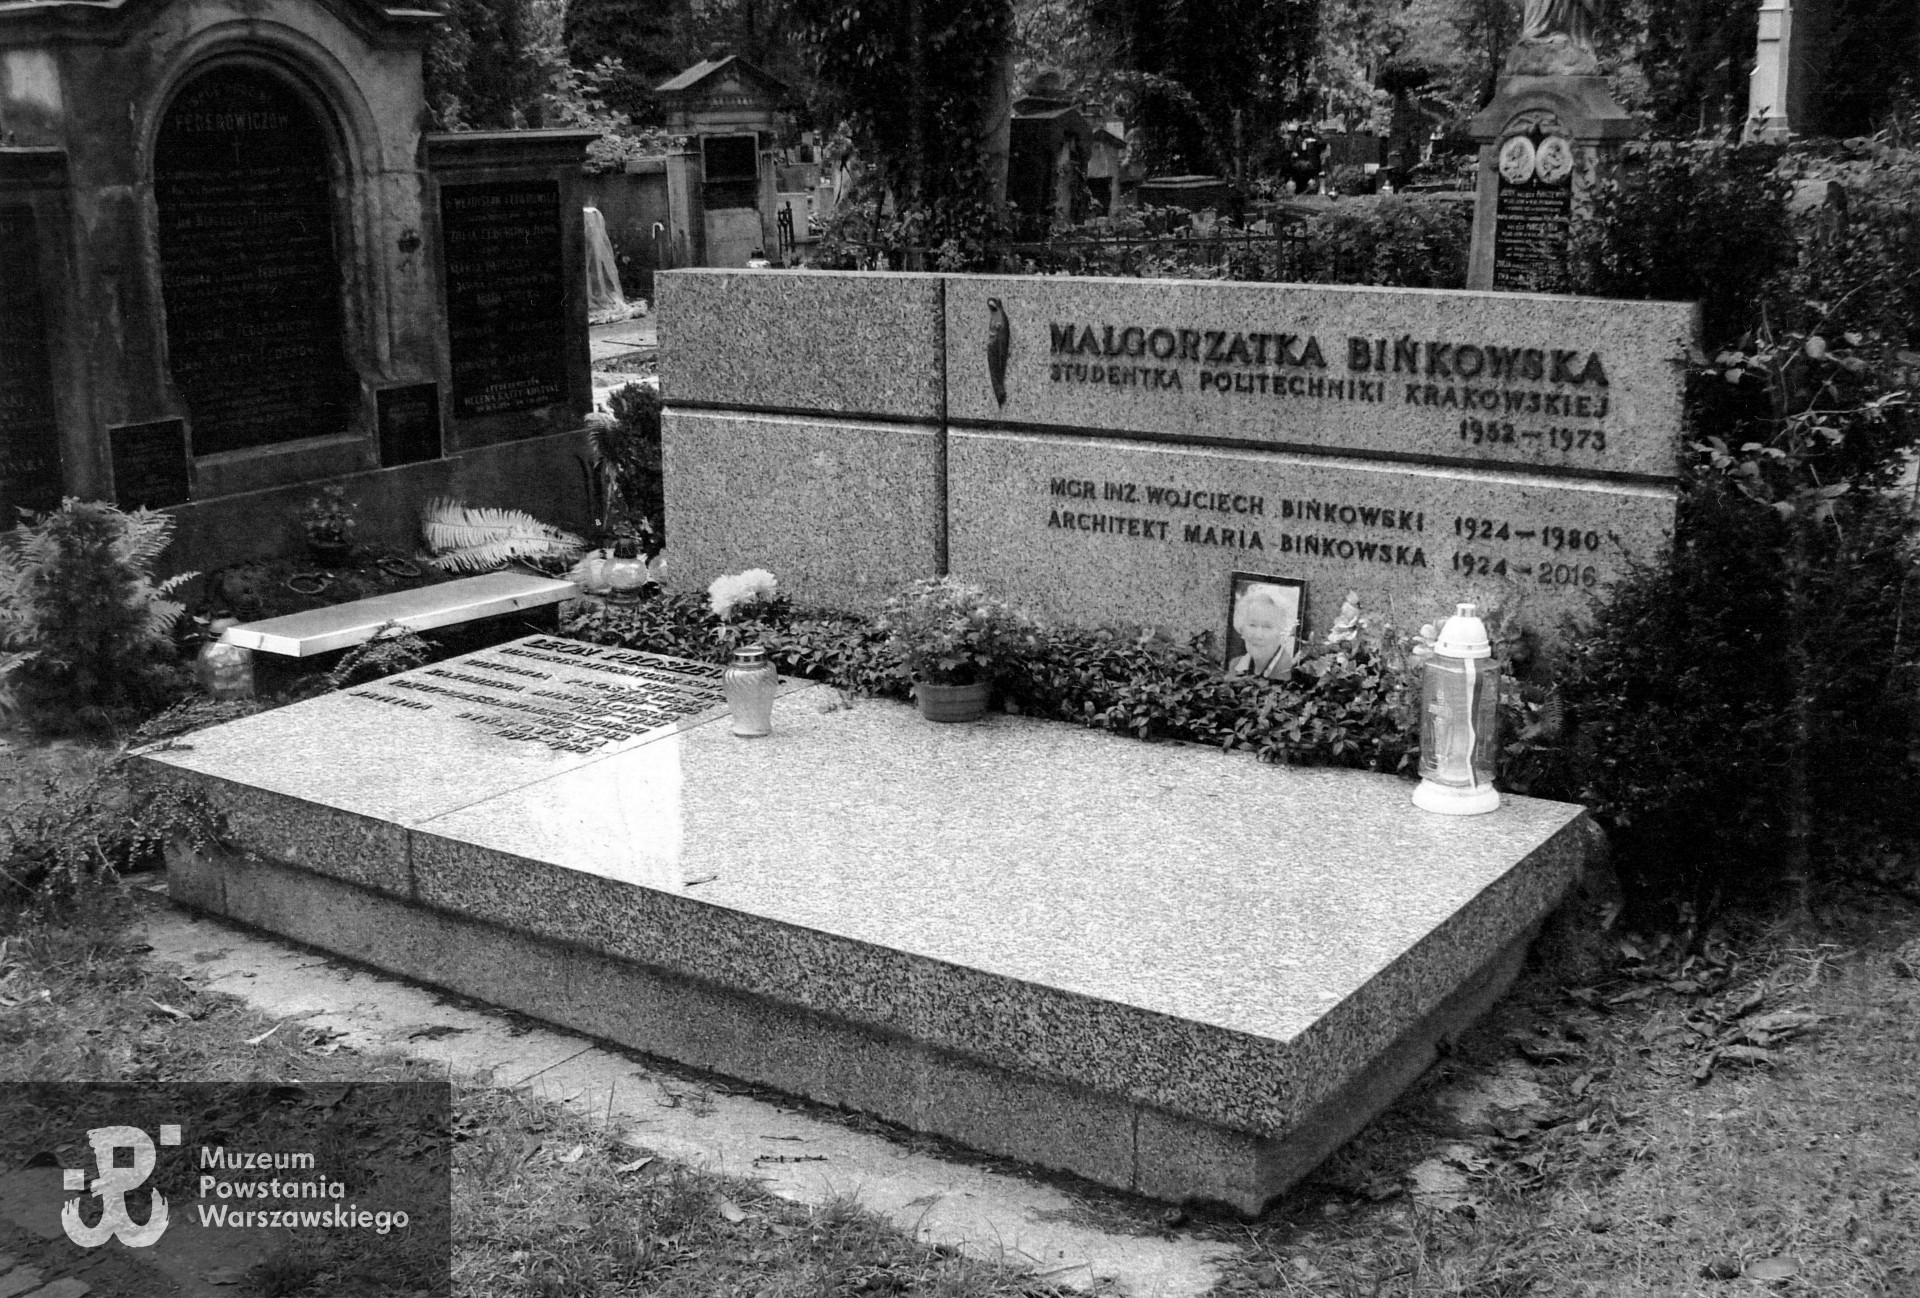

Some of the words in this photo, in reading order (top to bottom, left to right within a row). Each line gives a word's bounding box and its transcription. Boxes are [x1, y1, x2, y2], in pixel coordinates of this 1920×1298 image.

[1348, 334, 1609, 387] BIŃKOWSKA
[1050, 363, 1183, 390] STUDENTKA
[1200, 370, 1384, 402] POLITECHNIKI
[1405, 381, 1608, 418] KRAKOWSKIEJ
[1050, 477, 1097, 500] MGR
[1146, 485, 1264, 515] WOJCIECH
[1281, 498, 1424, 532] BIŃKOWSKI
[1048, 509, 1169, 540] ARCHITEKT
[1184, 524, 1264, 551] MARIA
[1280, 533, 1427, 568] BIŃKOWSKA
[522, 638, 604, 657] LEON
[424, 669, 527, 693] KAZIMIERA
[464, 659, 553, 681] WIKTORIA
[349, 691, 434, 711] JANINA
